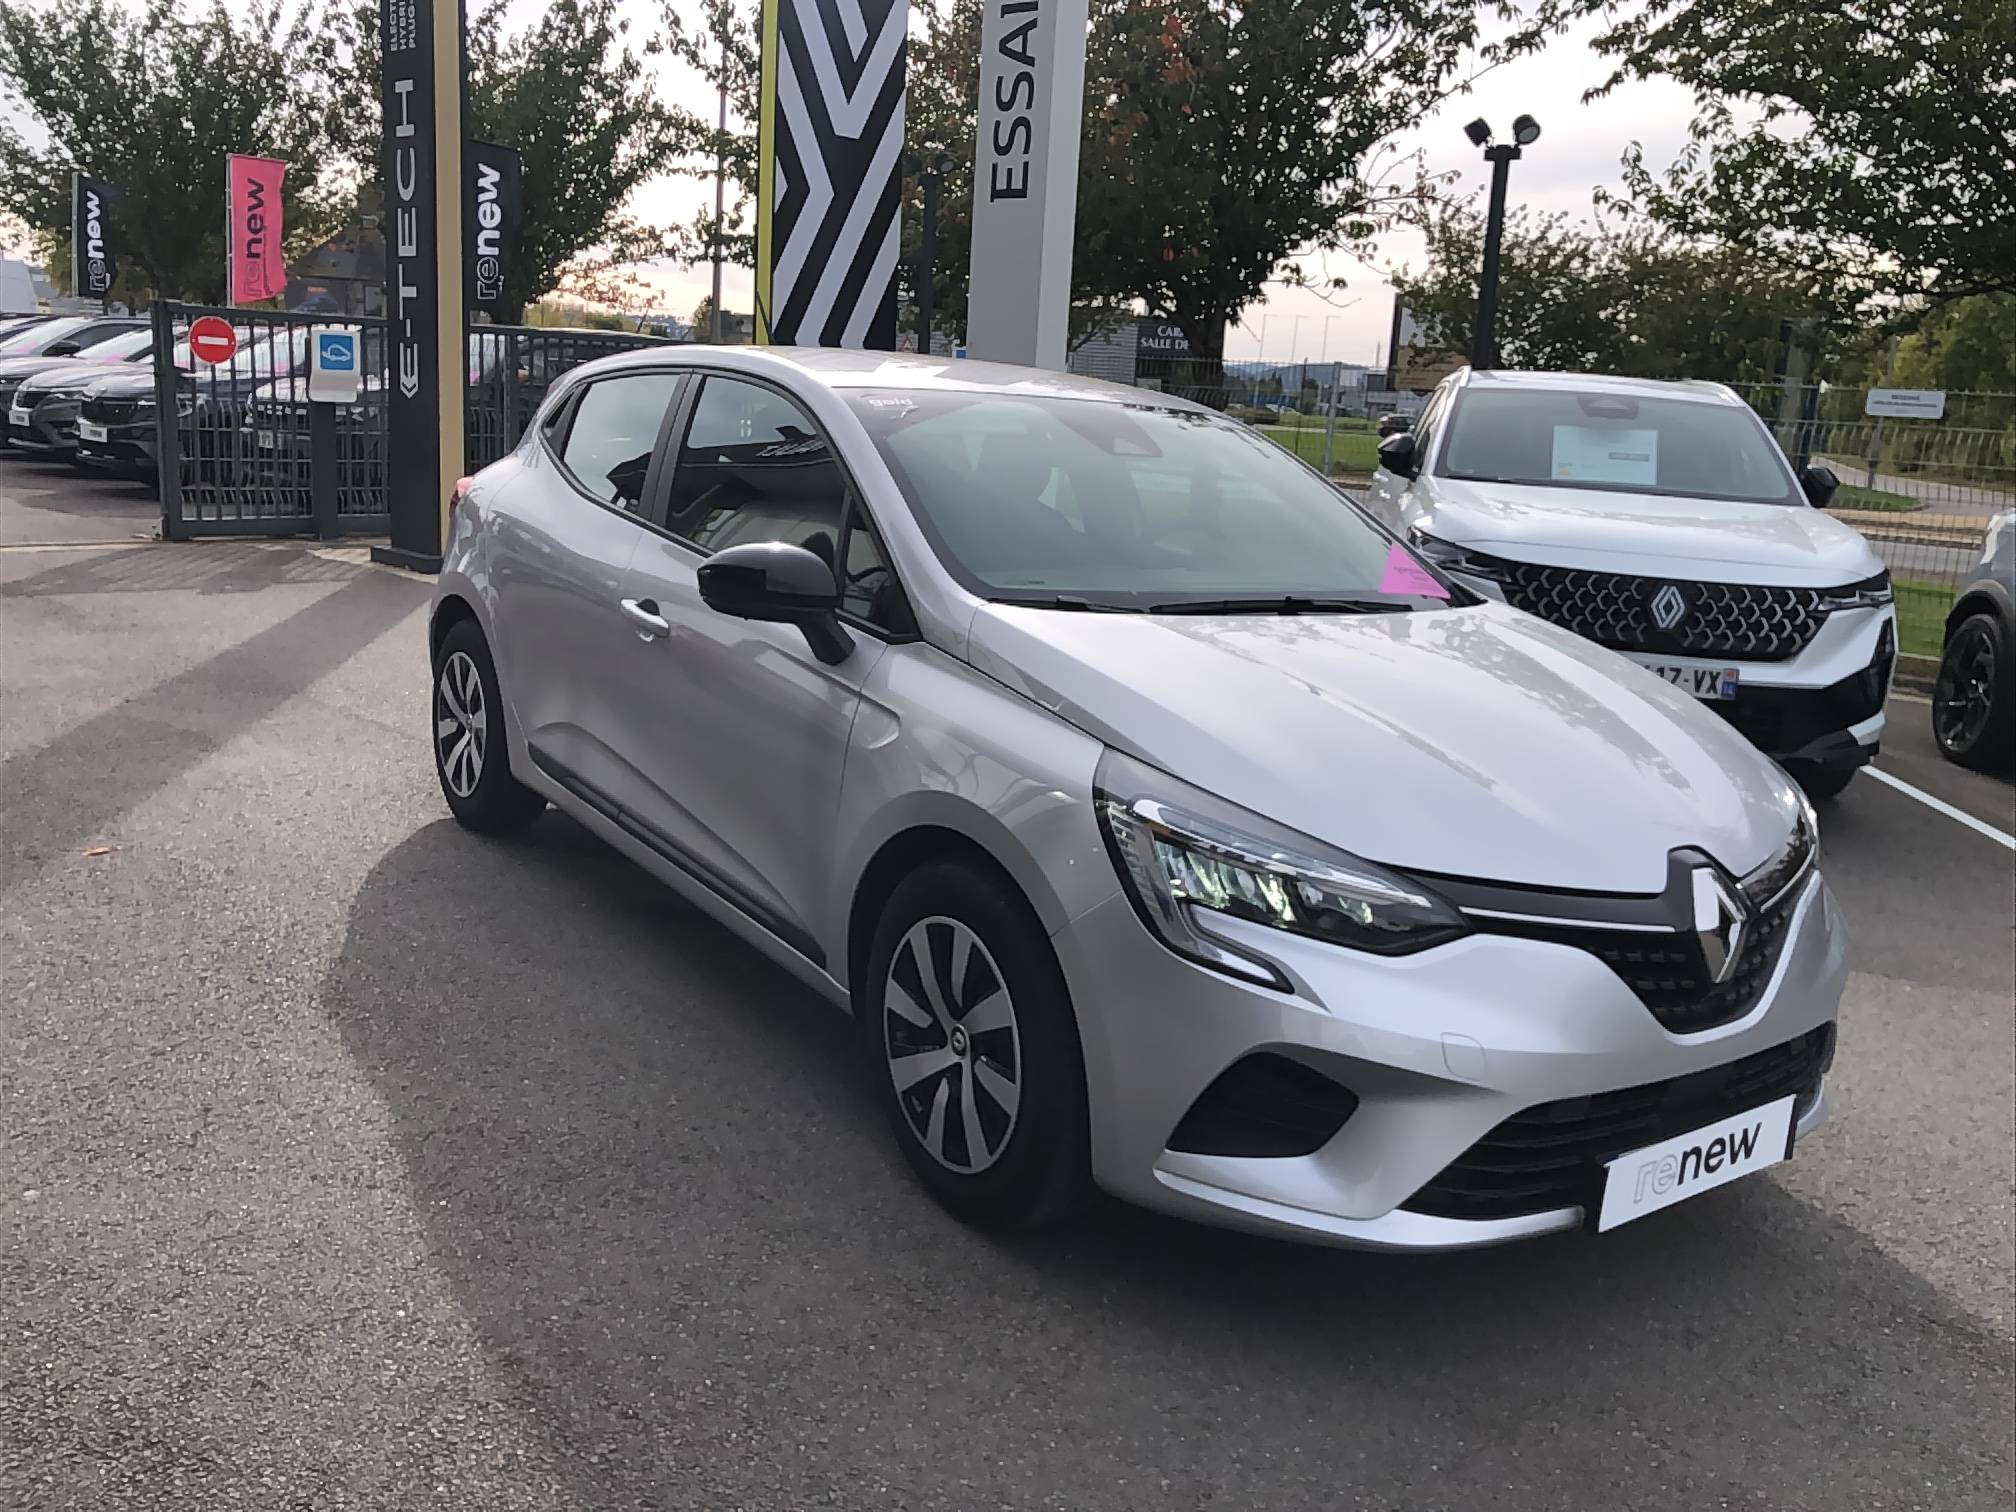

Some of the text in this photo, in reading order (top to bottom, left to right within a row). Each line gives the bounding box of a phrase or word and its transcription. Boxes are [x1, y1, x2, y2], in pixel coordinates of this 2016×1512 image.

[990, 1, 1039, 202] ESSAI
[86, 190, 106, 291] renew
[244, 178, 265, 298] renew
[395, 79, 419, 397] E-TECH
[477, 163, 501, 299] renew
[1141, 338, 1171, 348] SALLE
[1633, 1121, 1763, 1204] renew
